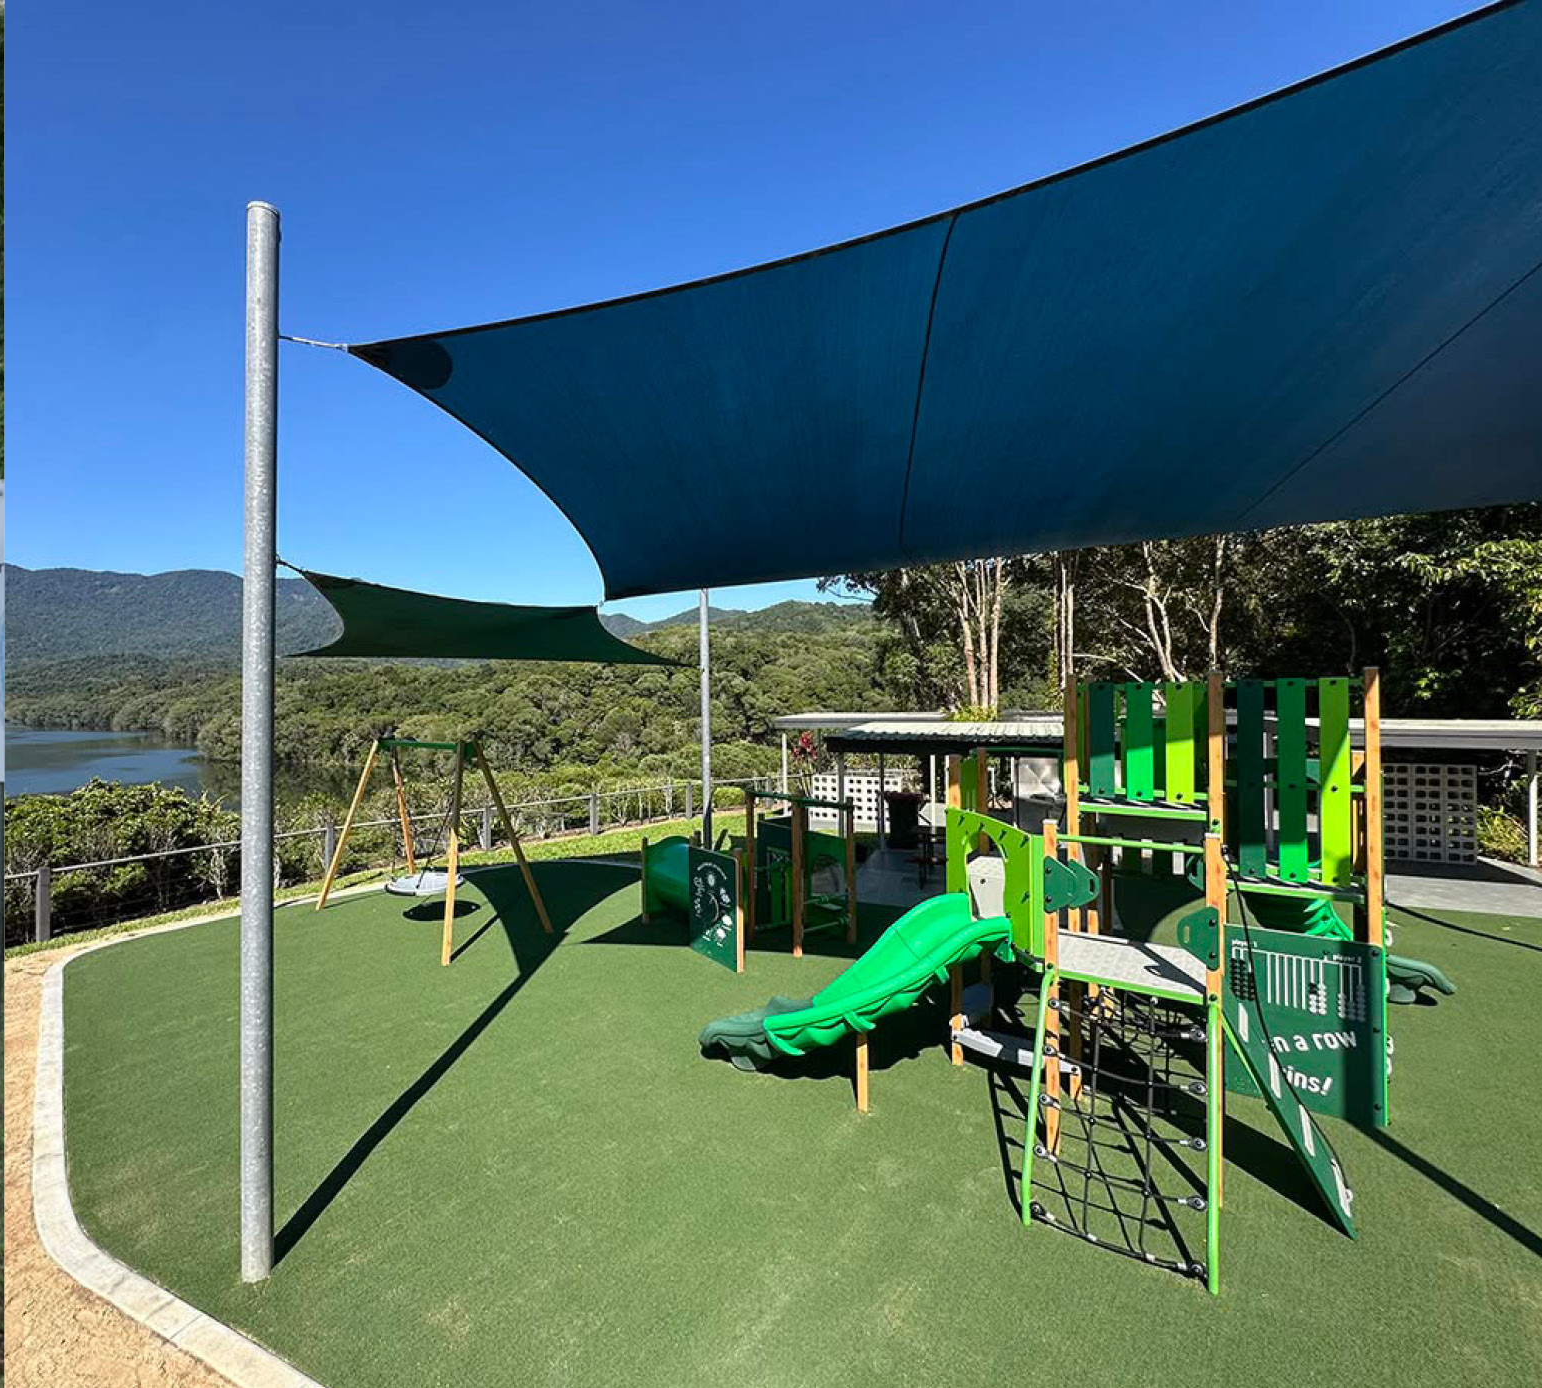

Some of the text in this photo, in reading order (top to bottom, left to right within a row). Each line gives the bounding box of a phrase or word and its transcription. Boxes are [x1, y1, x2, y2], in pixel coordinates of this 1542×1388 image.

[1293, 1034, 1309, 1052] a
[1311, 1031, 1357, 1050] row
[1282, 1065, 1334, 1096] ins!
